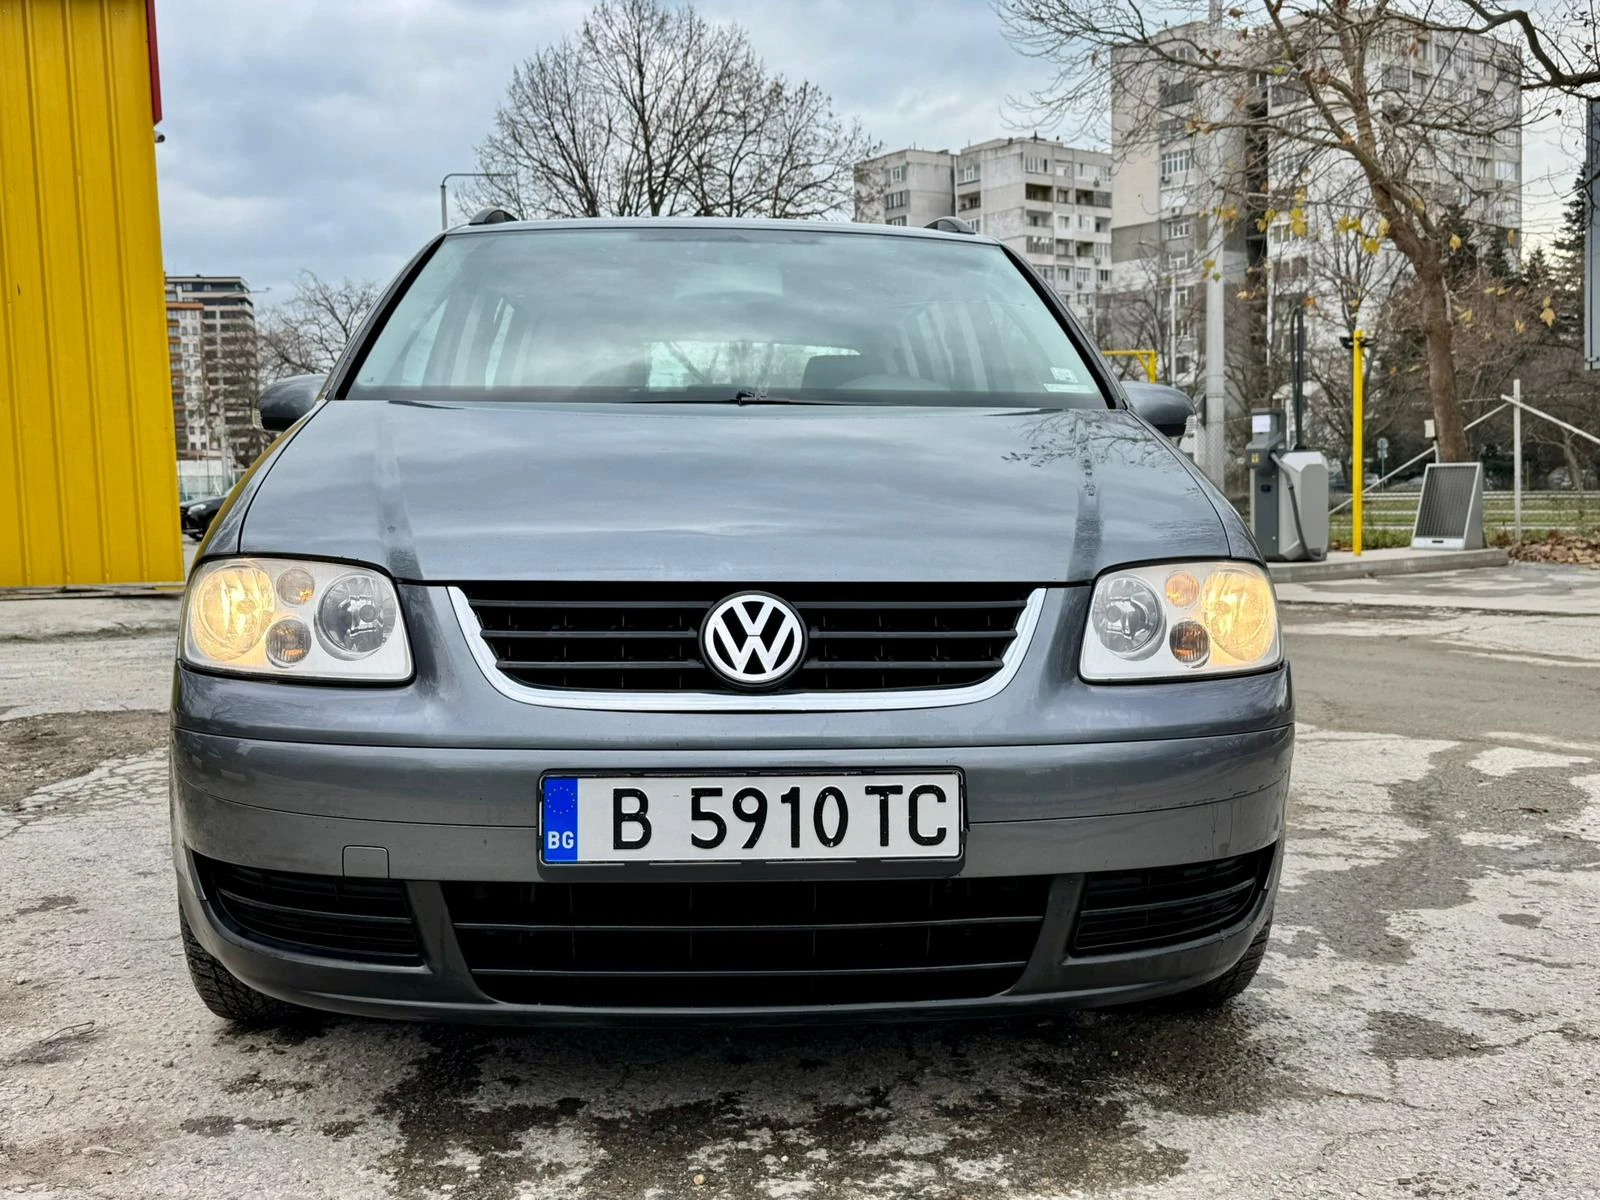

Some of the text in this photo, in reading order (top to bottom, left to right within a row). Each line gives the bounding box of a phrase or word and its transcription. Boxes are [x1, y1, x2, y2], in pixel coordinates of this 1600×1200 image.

[705, 594, 803, 682] VW
[547, 831, 575, 849] BG
[612, 784, 947, 850] B 5910 TC
